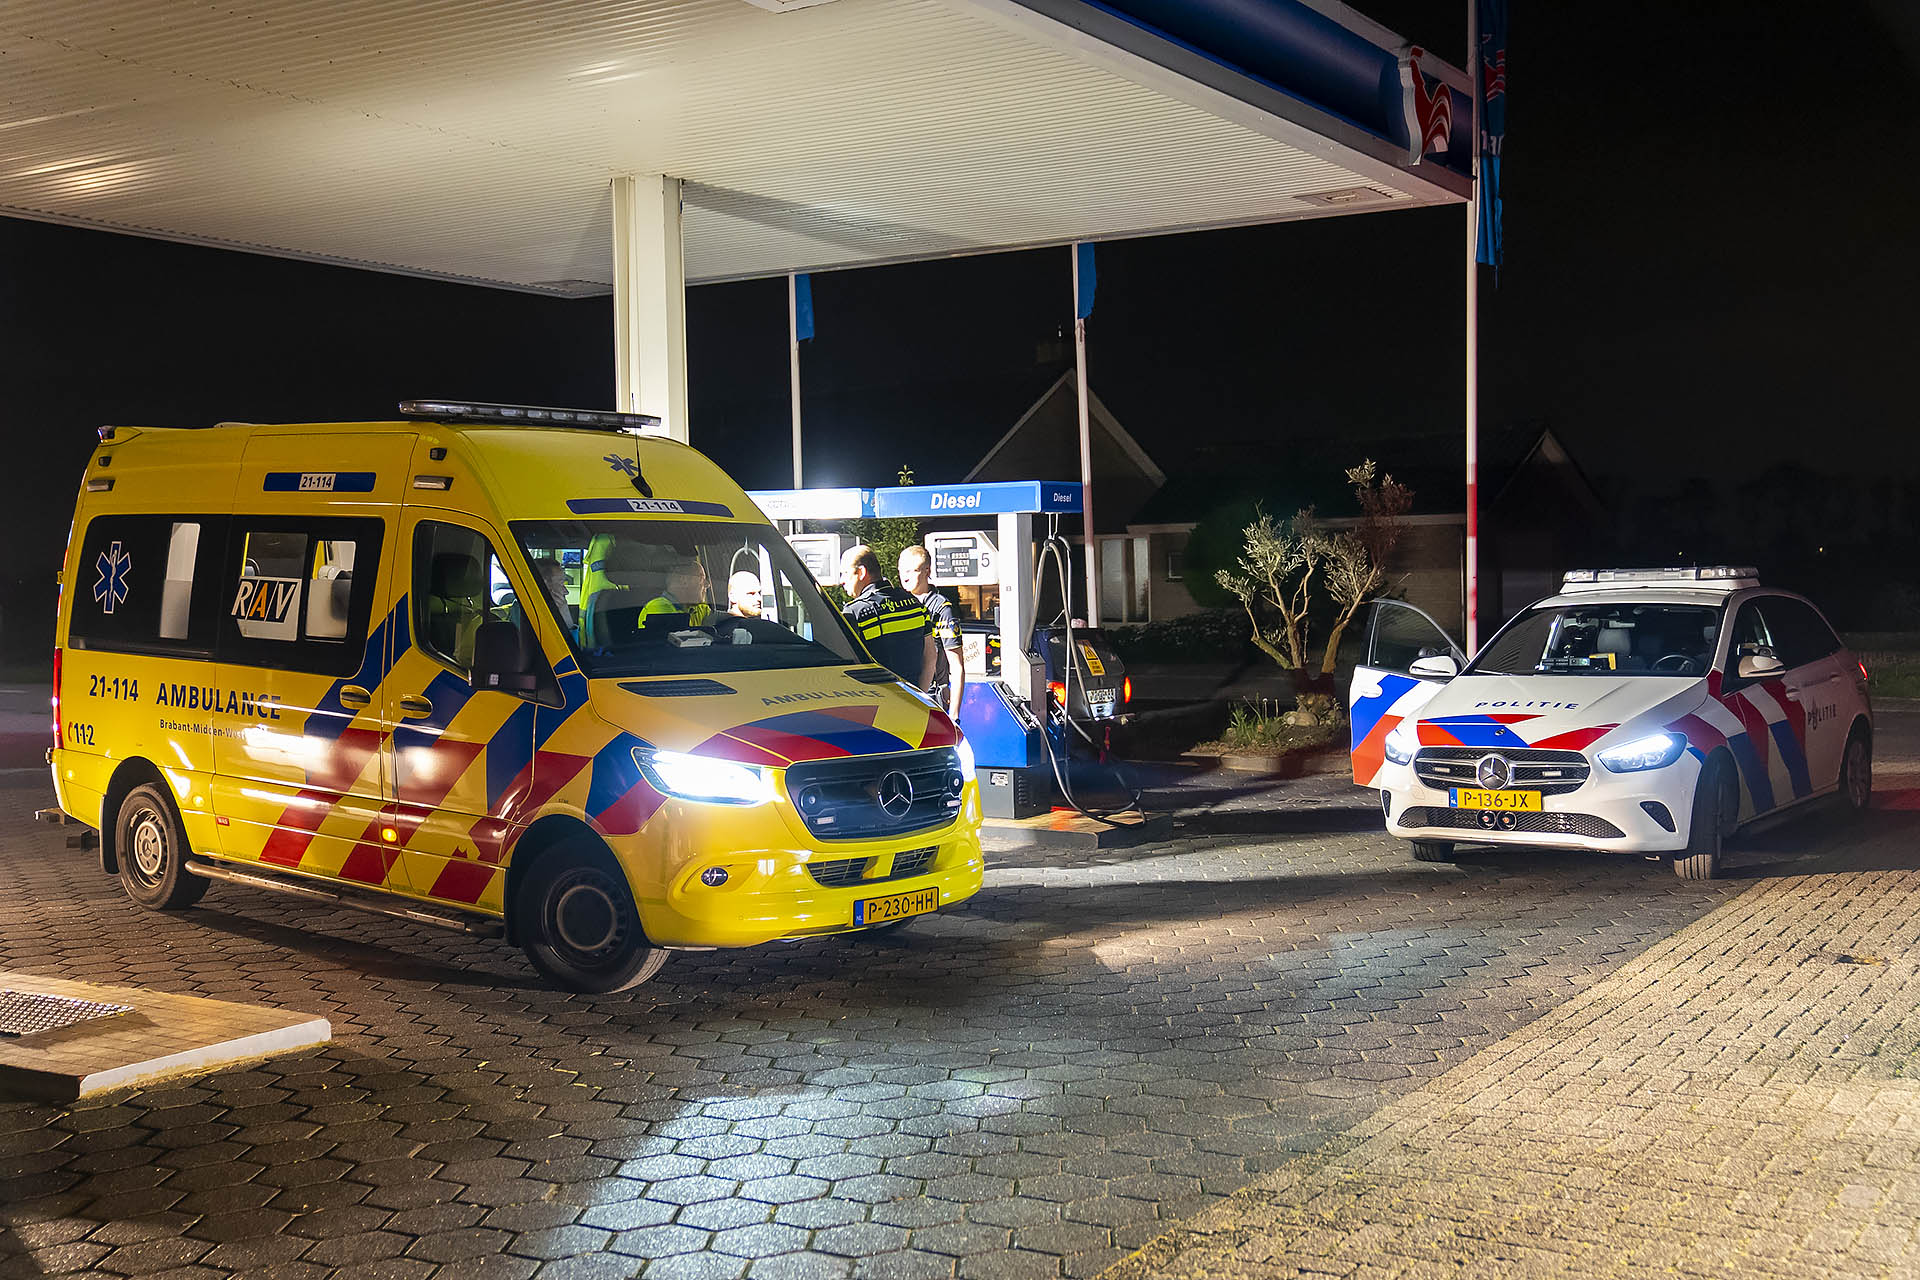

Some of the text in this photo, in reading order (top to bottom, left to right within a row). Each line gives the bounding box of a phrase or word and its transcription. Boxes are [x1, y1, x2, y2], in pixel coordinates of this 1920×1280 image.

[301, 476, 332, 488] 21-114
[632, 500, 679, 510] 21-114
[930, 491, 982, 510] Diesel
[1053, 492, 1072, 502] Diesel
[981, 552, 990, 568] 5
[231, 581, 296, 620] RAV
[89, 674, 281, 720] 21-114 AMBULANCE
[761, 690, 886, 706] AMBULANCE
[1474, 701, 1580, 710] POLITIE
[1463, 791, 1529, 808] P-136-JX
[868, 891, 934, 921] P-230-HH
